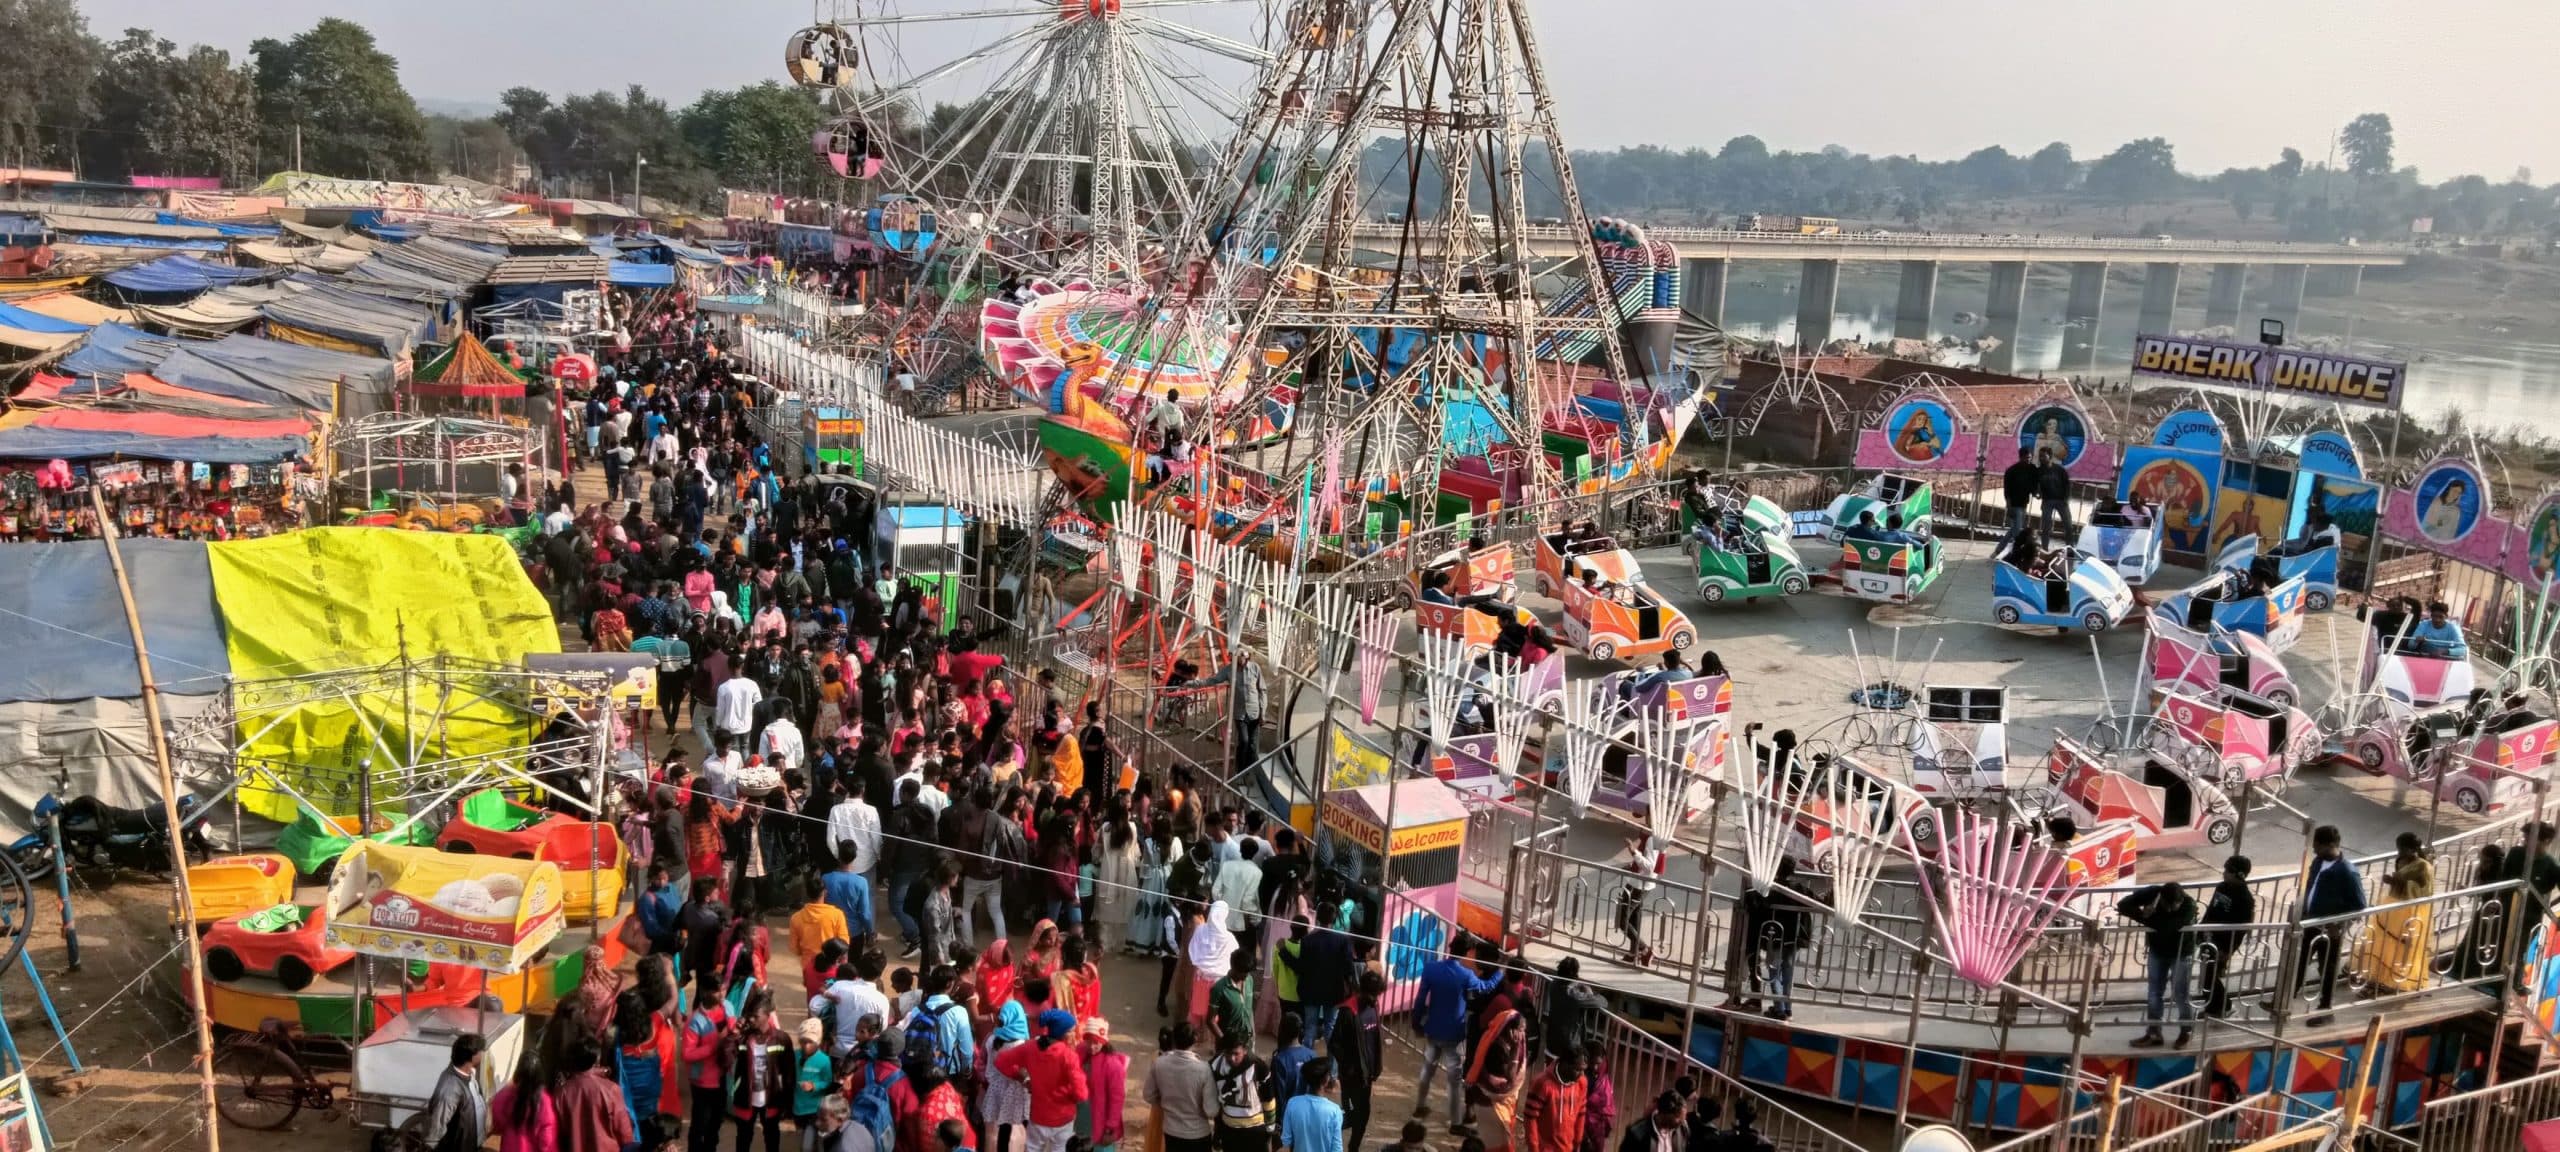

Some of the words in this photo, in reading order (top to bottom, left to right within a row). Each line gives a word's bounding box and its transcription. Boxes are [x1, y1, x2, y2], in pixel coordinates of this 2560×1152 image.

[2138, 339, 2262, 384] BREAK
[2271, 353, 2395, 402] DANCE
[2160, 423, 2218, 446] Welcome
[1322, 803, 1381, 850] BOOKING
[423, 917, 460, 932] Premium
[462, 921, 499, 938] Quality
